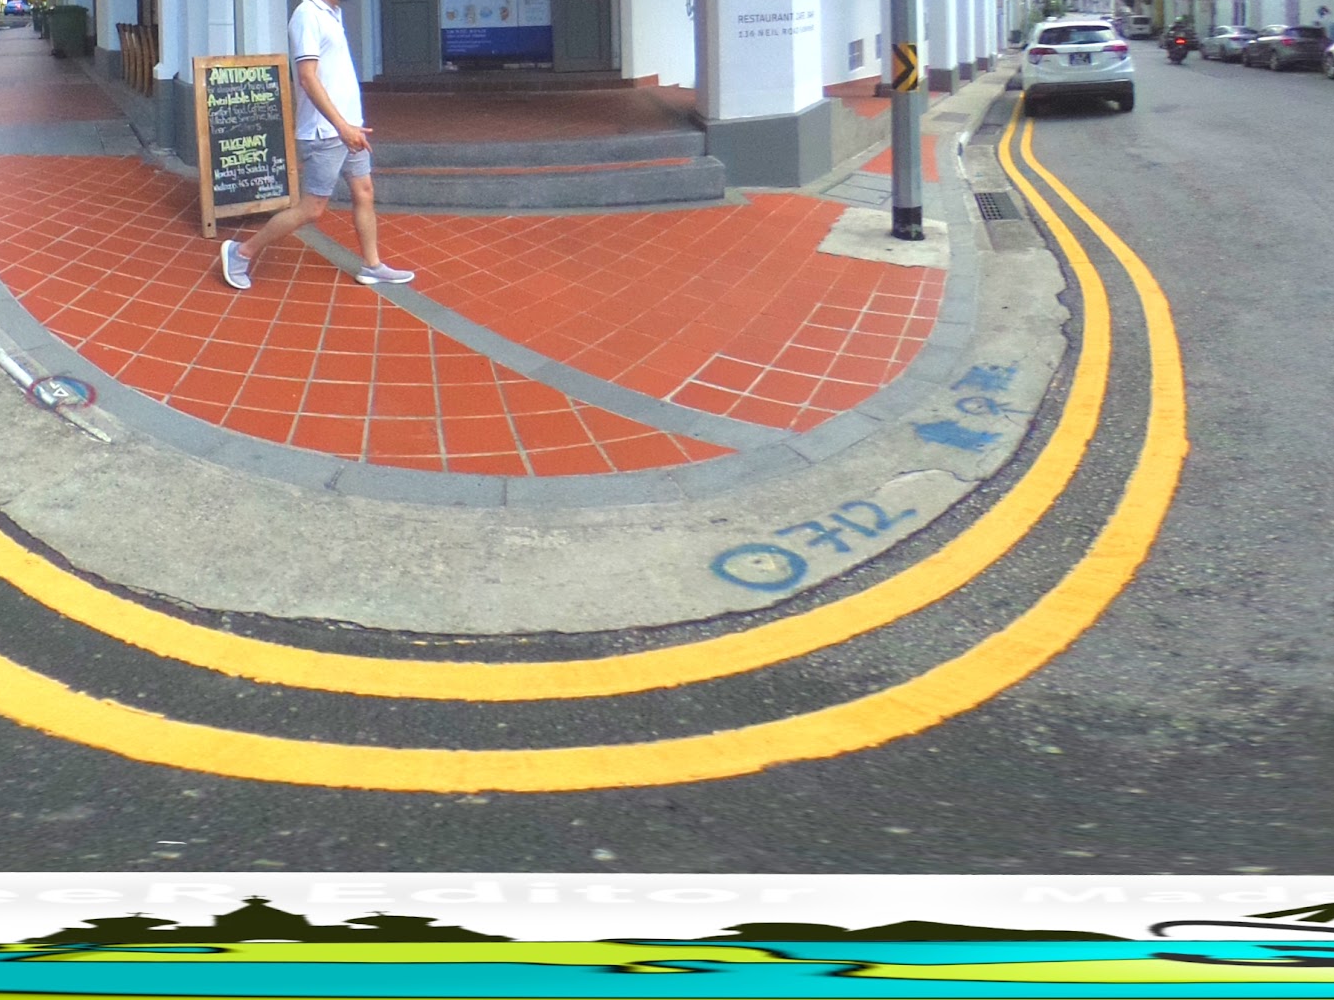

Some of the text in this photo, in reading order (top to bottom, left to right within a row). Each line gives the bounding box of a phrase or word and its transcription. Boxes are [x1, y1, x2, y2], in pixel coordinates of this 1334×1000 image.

[737, 12, 793, 24] RESTAURANT
[209, 66, 273, 85] ANTIDOTE
[208, 90, 275, 107] Available here
[218, 134, 267, 152] TAKEAWAY
[219, 148, 269, 168] DELIVERY
